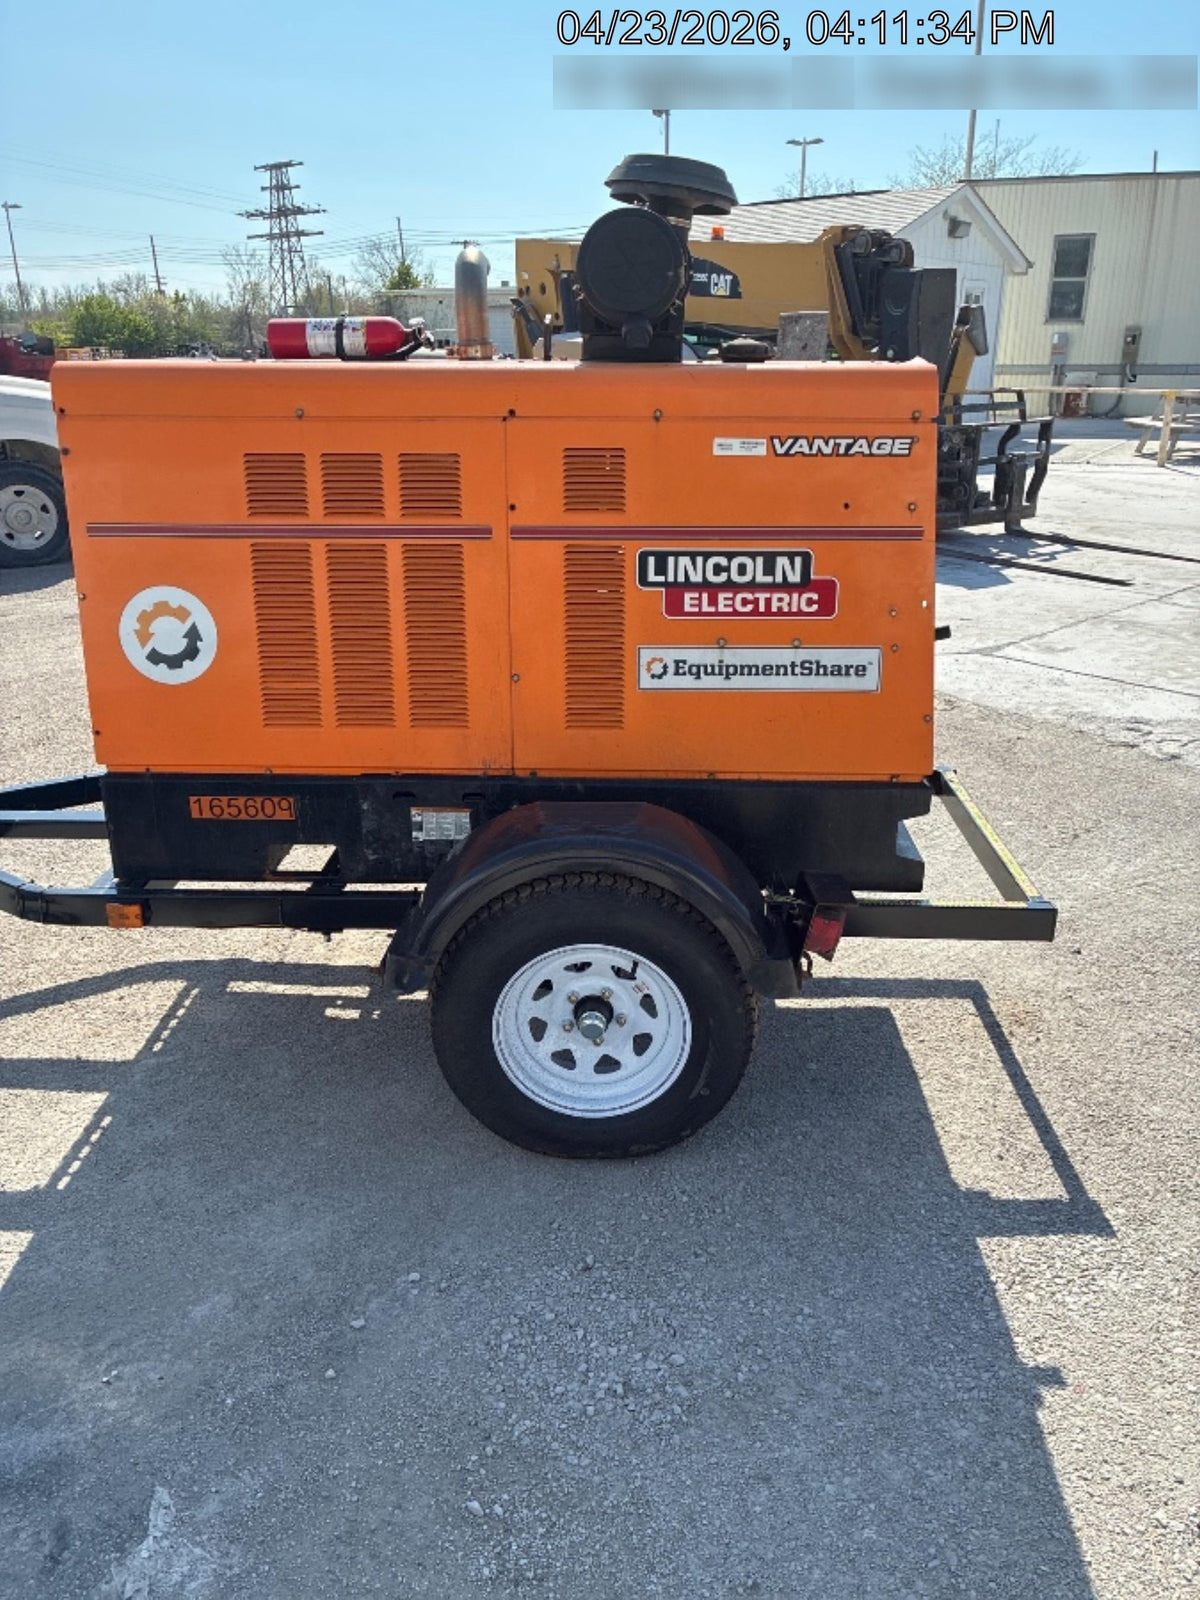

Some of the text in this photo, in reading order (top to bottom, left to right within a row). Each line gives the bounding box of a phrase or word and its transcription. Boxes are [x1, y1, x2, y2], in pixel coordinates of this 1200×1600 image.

[711, 273, 733, 296] CAT
[771, 437, 914, 456] VANTAGE
[646, 556, 803, 584] LINCOLN
[683, 592, 819, 613] ELECTRIC
[192, 797, 295, 819] 165609
